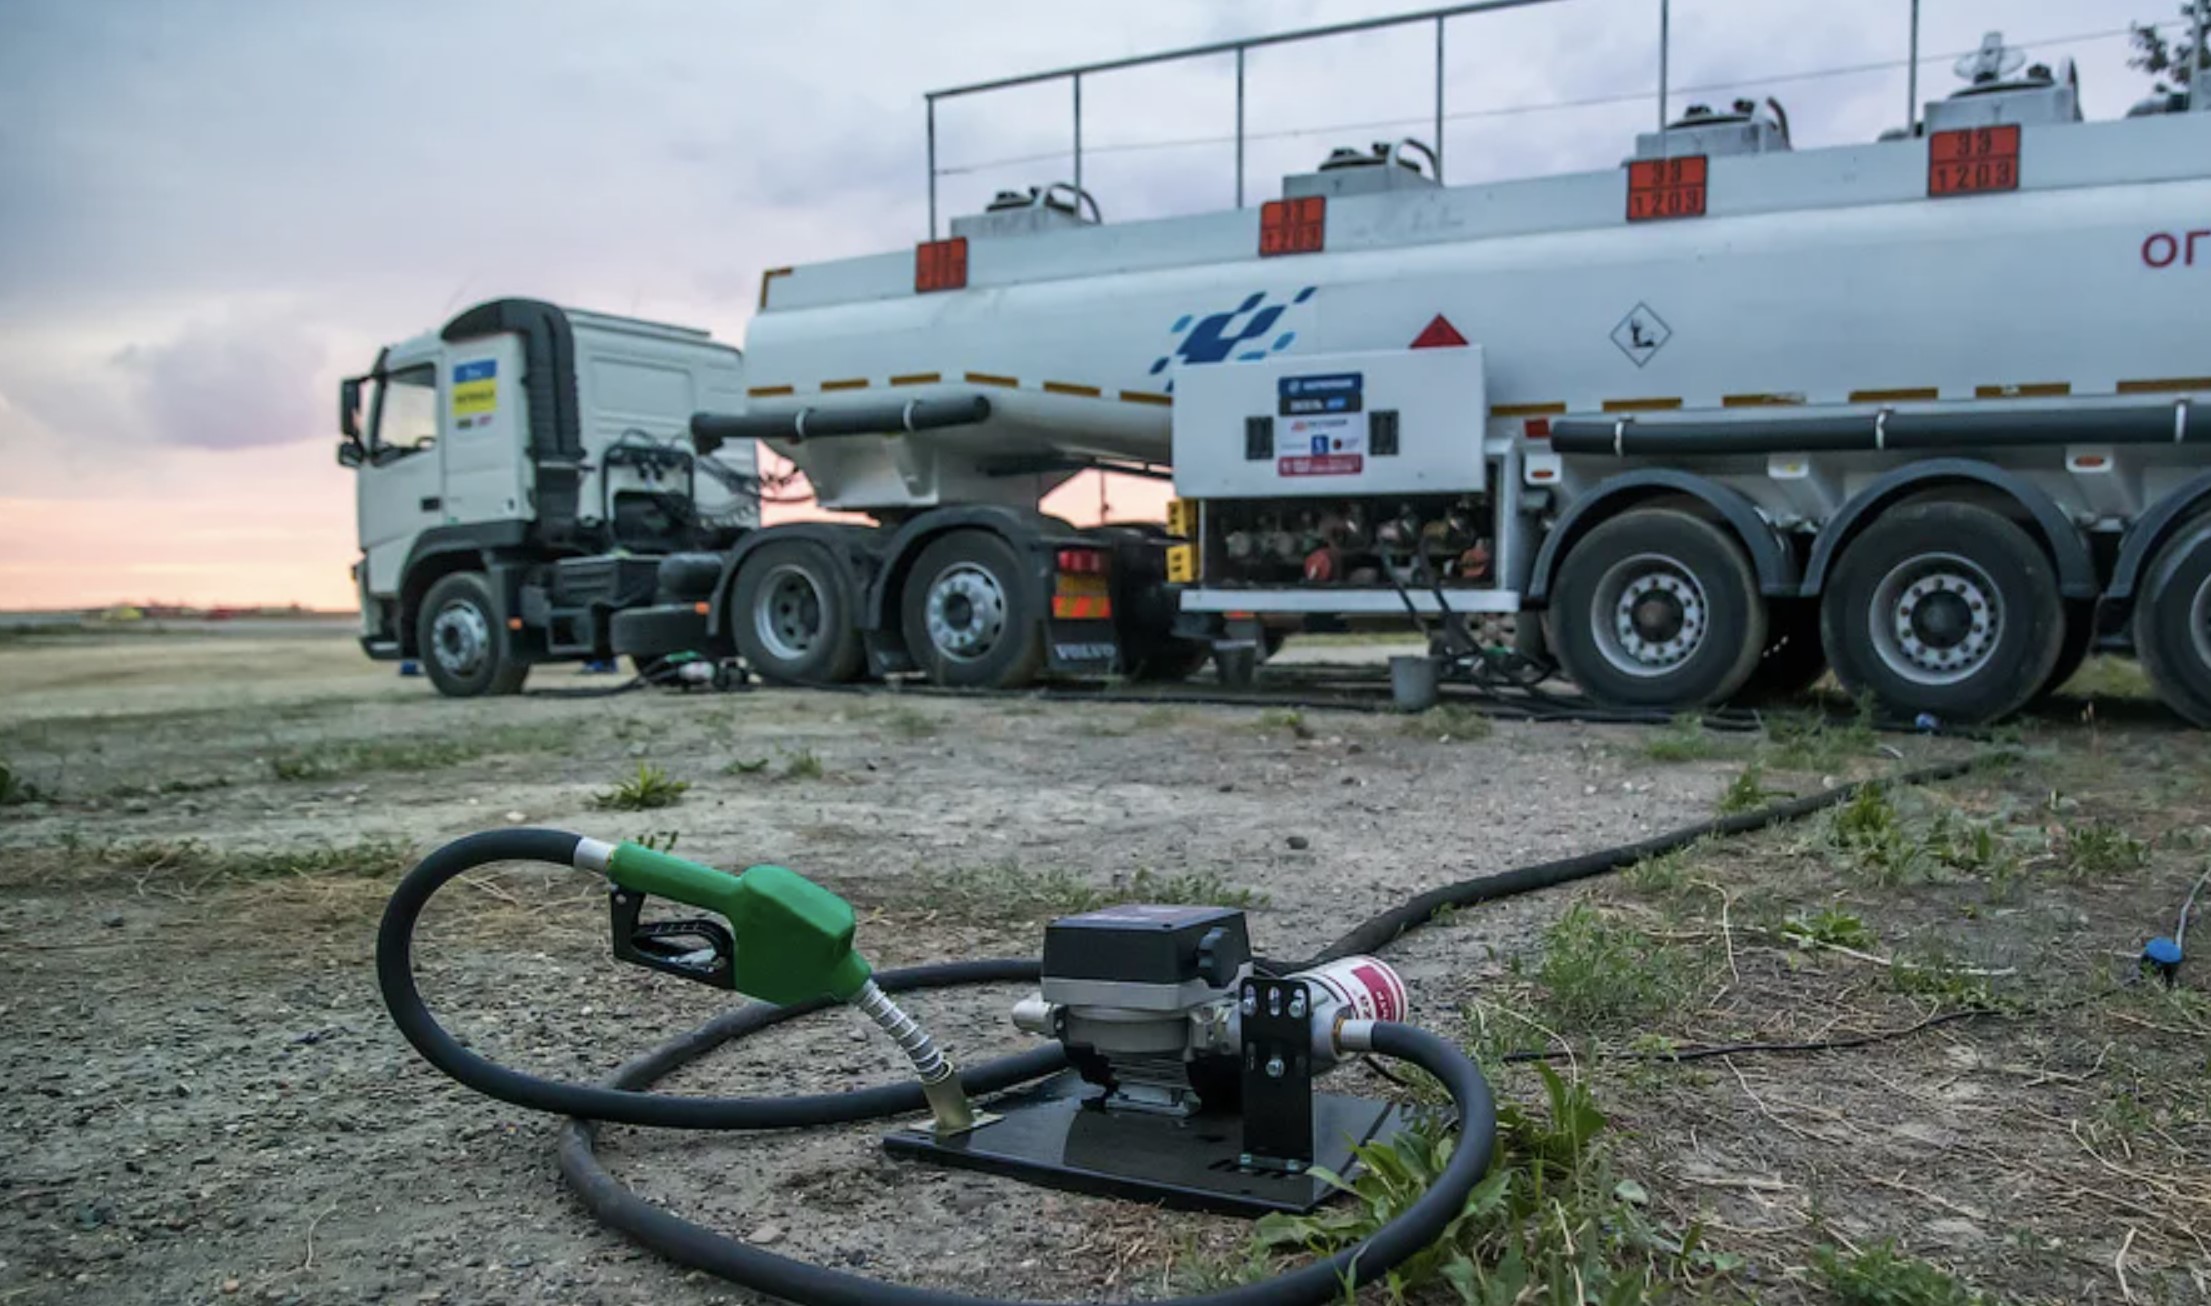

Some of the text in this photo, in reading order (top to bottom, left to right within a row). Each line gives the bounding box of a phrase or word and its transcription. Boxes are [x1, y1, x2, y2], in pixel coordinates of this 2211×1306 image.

[1938, 158, 2010, 189] 1203
[1634, 187, 1698, 215] 1203
[1054, 643, 1115, 660] VOLVO
